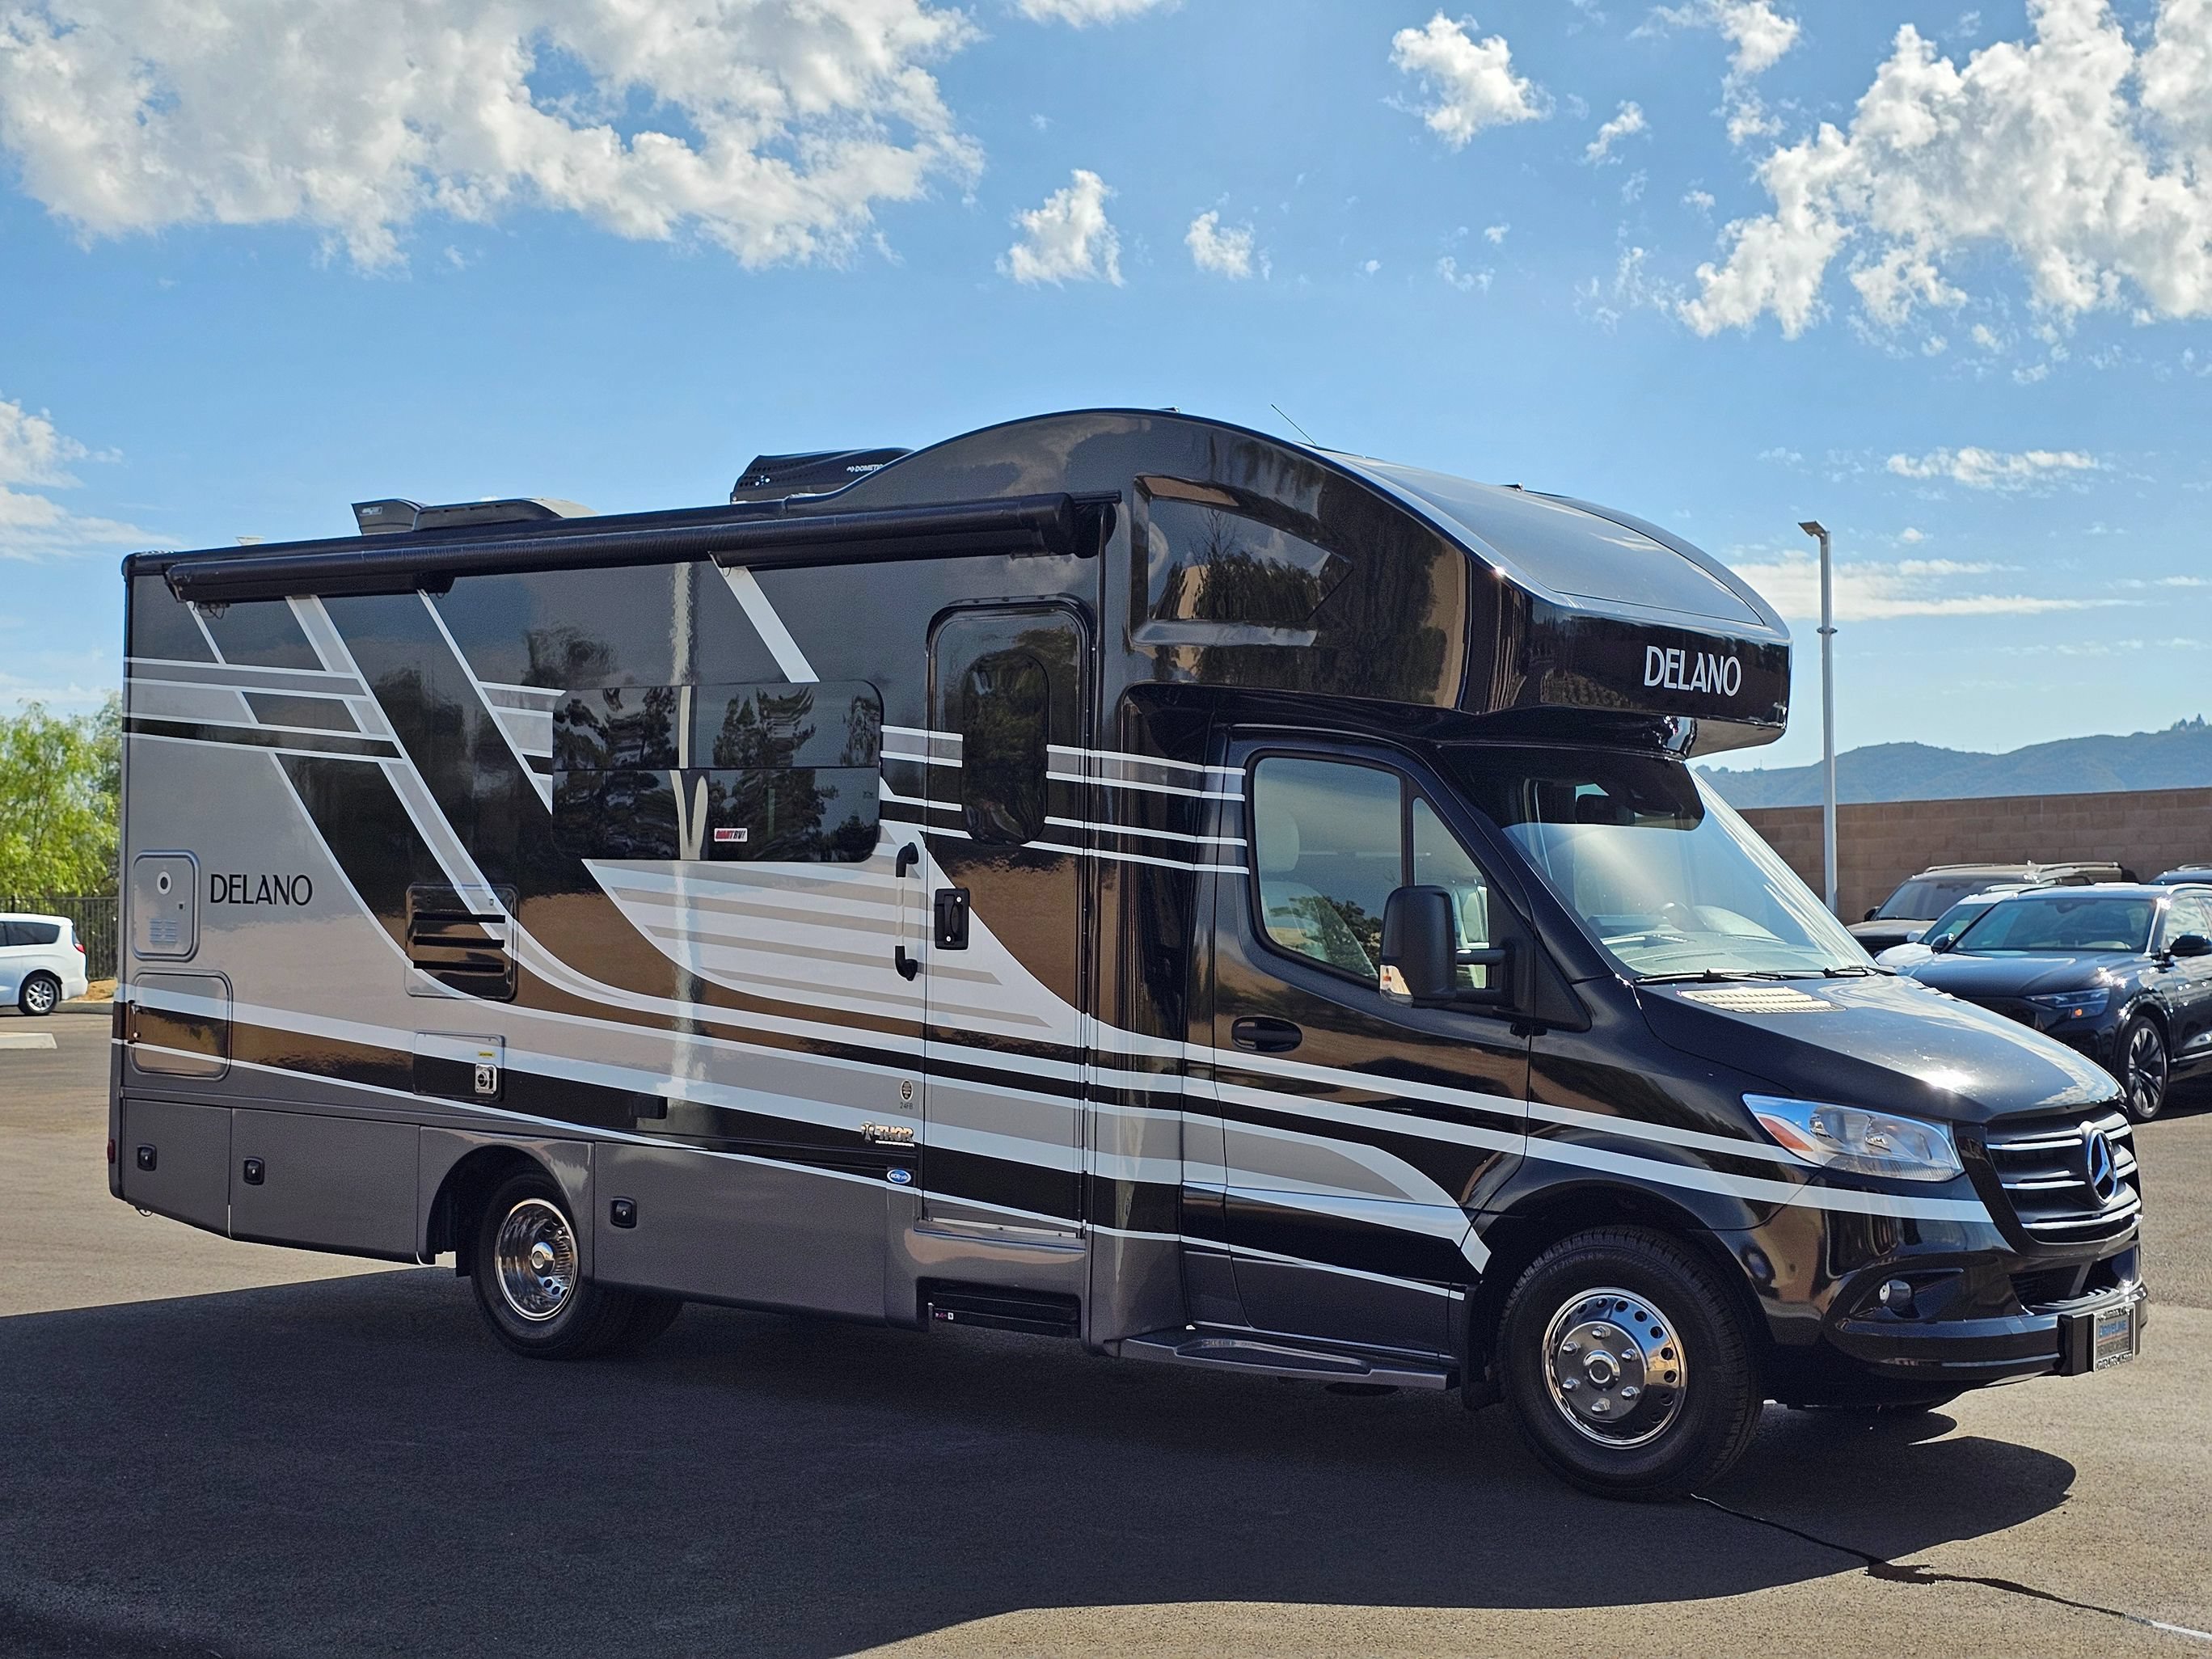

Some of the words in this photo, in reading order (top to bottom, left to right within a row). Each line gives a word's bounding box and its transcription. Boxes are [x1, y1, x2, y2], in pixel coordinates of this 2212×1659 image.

[1644, 645, 1741, 697] DELANO
[210, 873, 314, 906] DELANO
[874, 1125, 914, 1142] THOR
